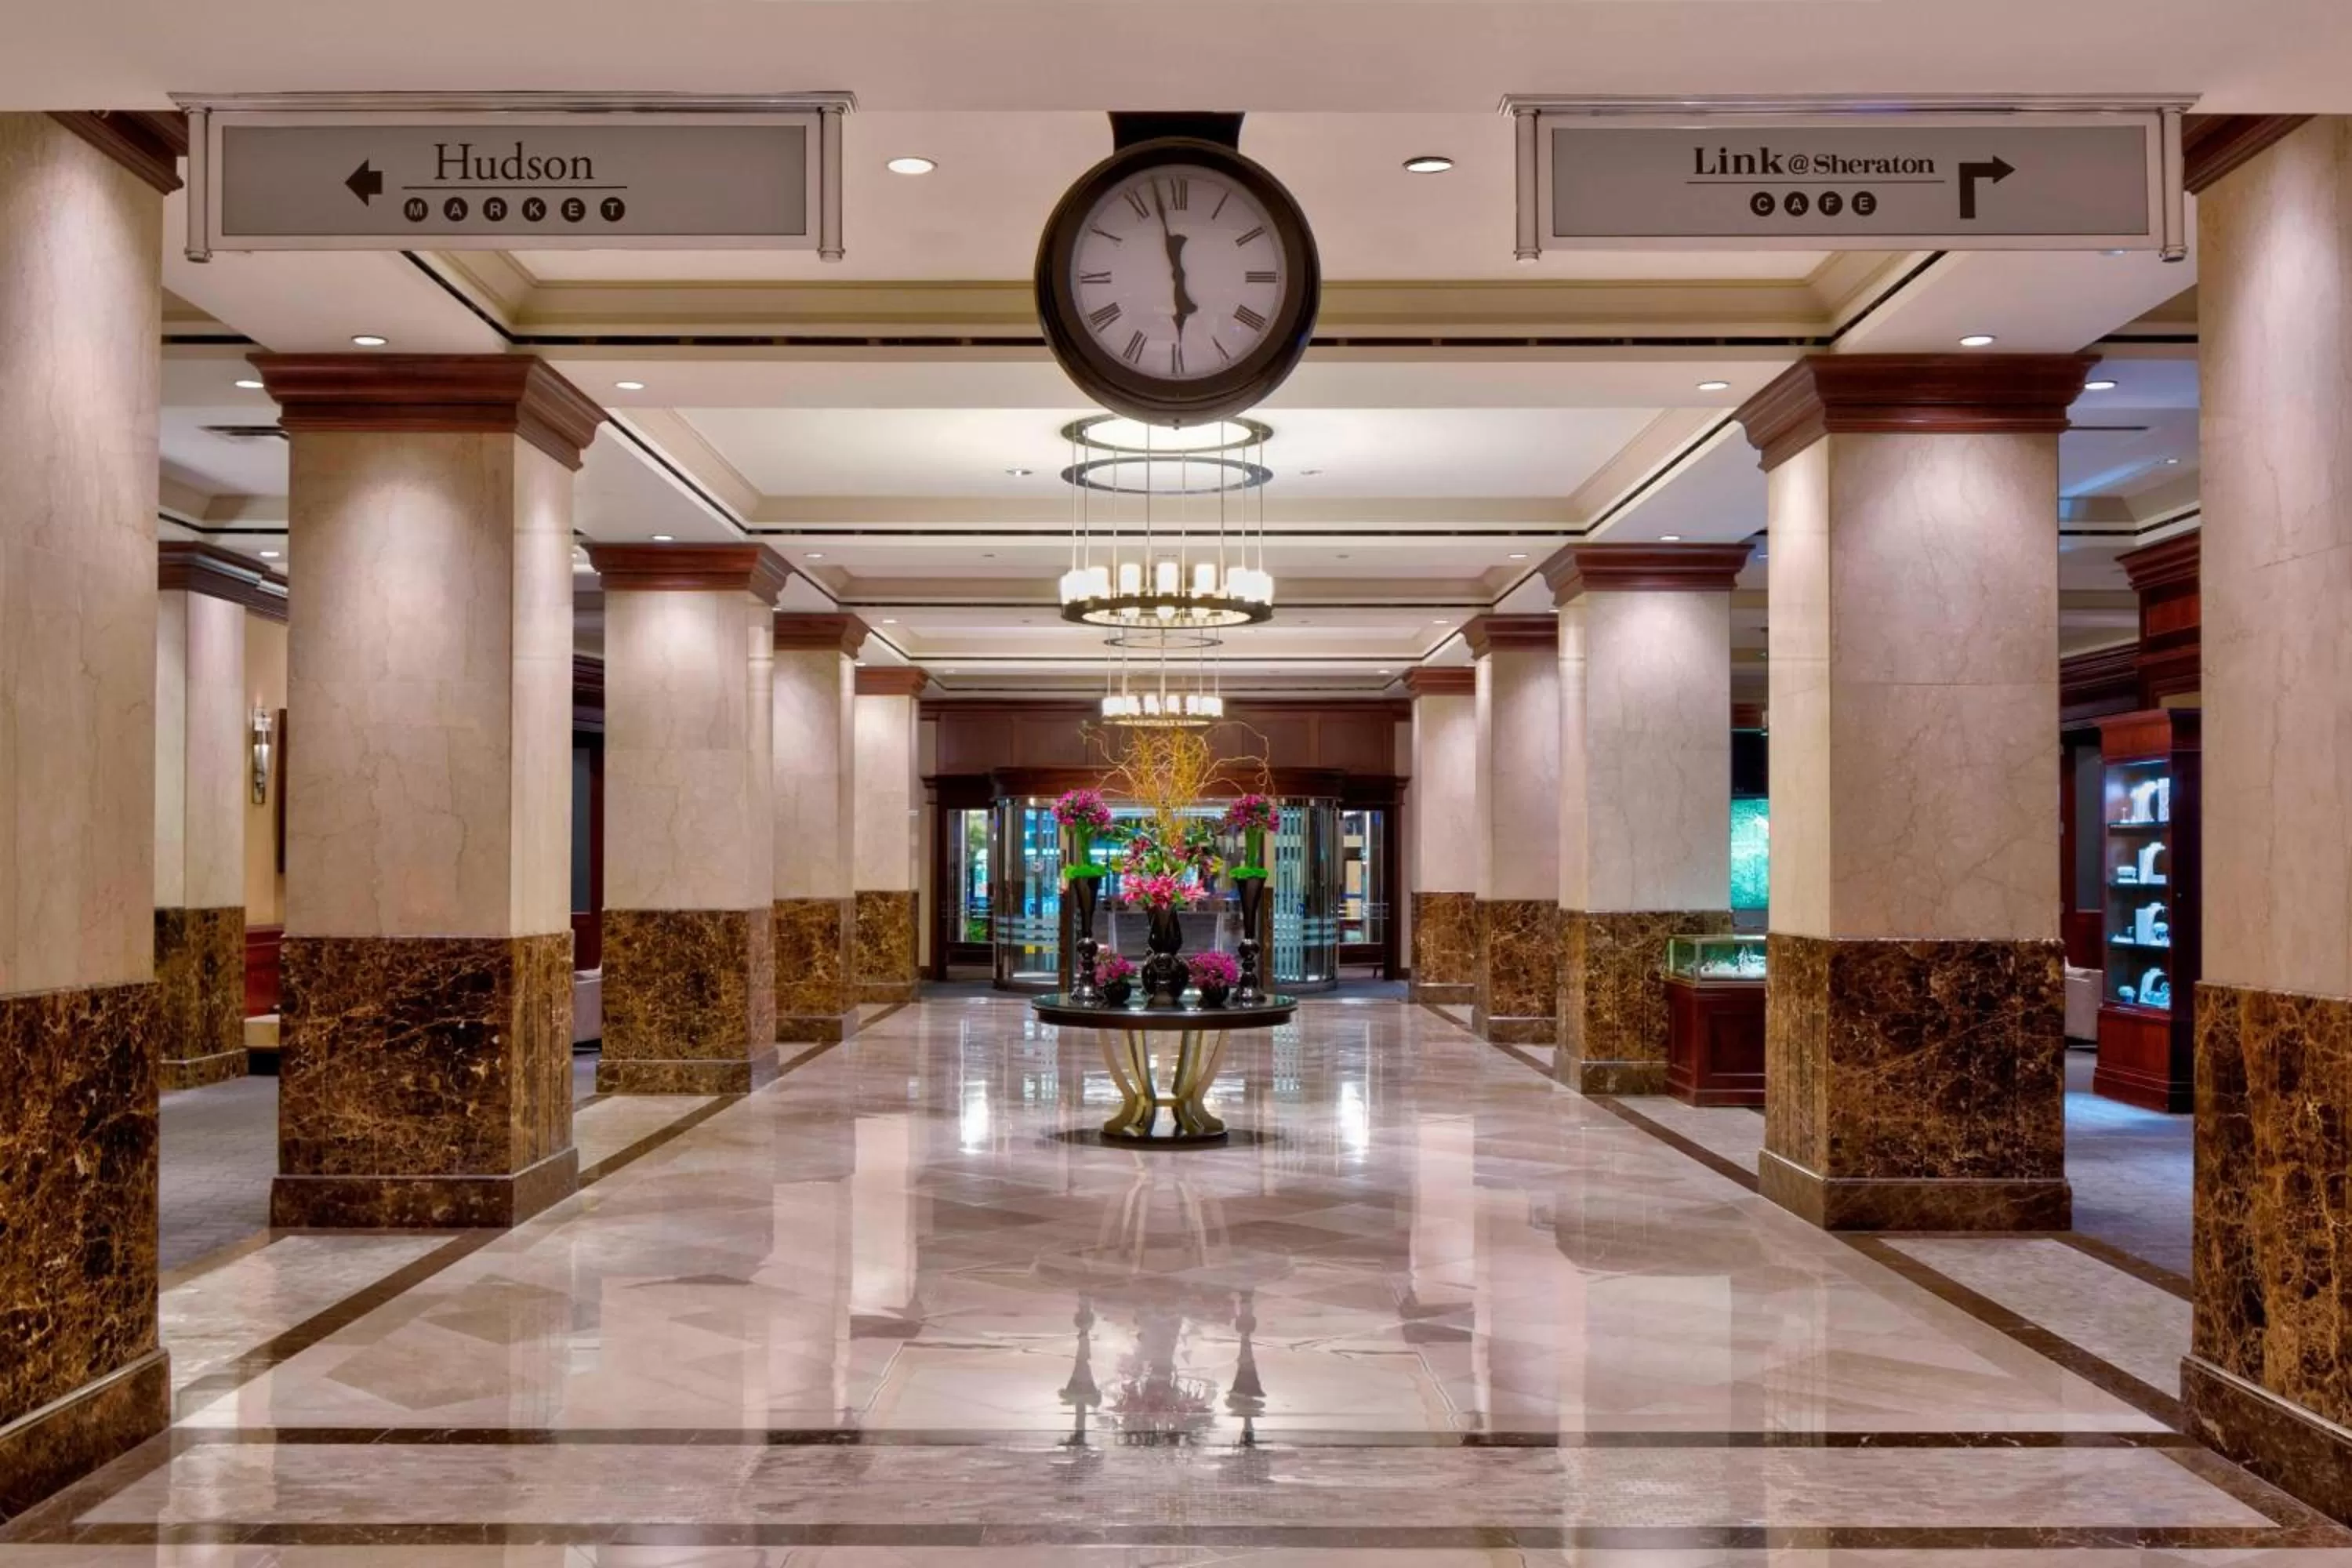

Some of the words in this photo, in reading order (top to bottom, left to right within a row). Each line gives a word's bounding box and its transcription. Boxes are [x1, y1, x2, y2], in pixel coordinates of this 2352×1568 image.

[433, 141, 595, 180] Hudson
[405, 198, 624, 221] MARKET
[1751, 194, 1875, 215] CAFE
